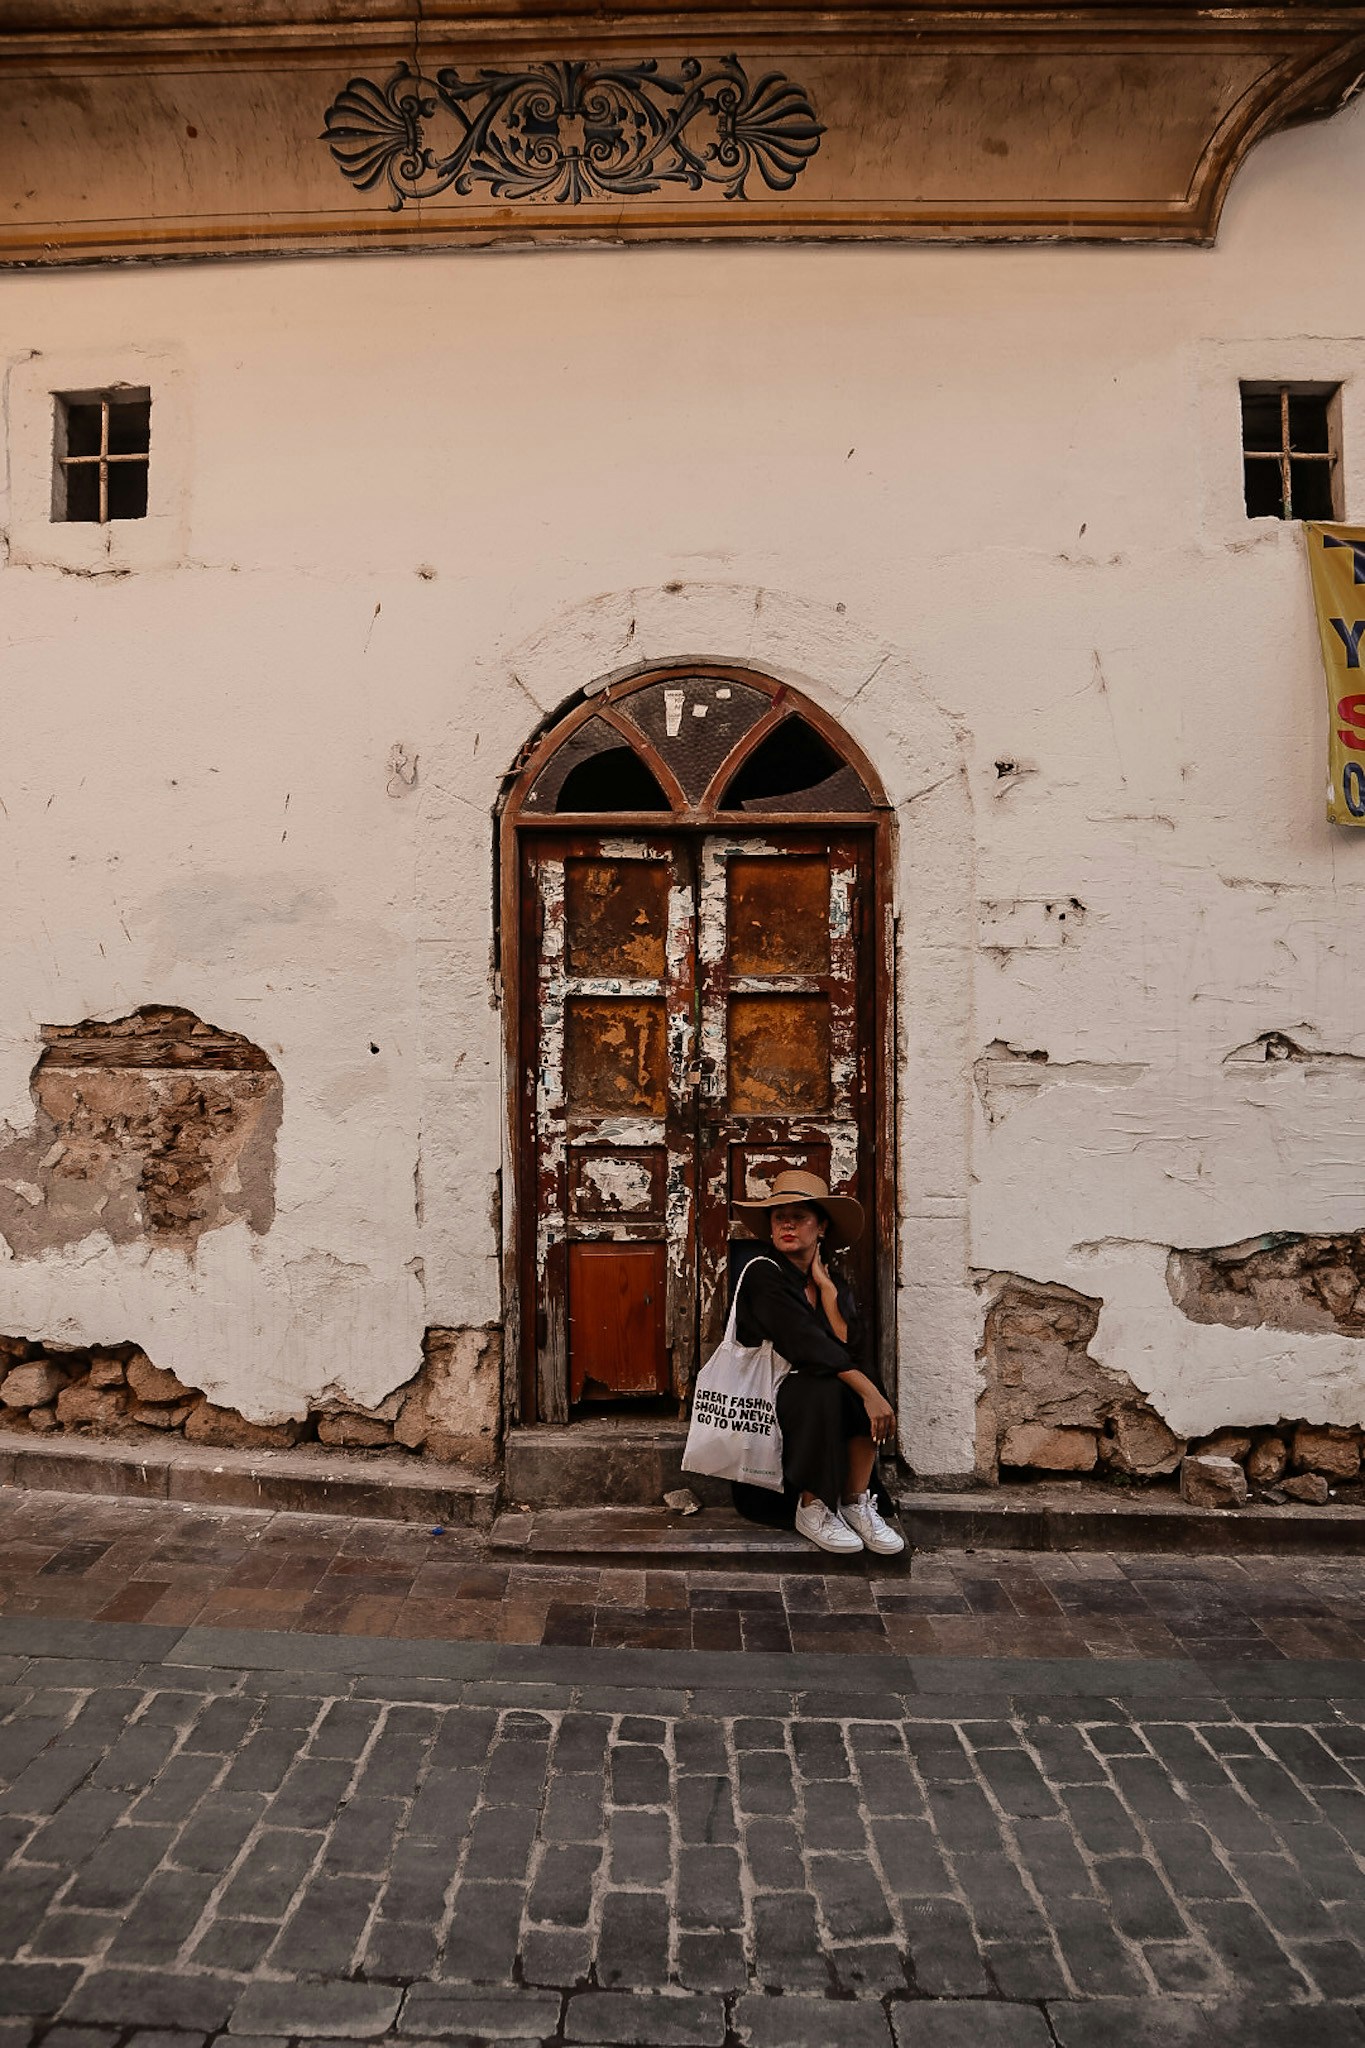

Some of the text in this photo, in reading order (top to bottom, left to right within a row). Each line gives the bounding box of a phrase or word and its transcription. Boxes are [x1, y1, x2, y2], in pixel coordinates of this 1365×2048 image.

[697, 1389, 728, 1405] GREAT
[695, 1400, 776, 1425] SHOULD NEVER
[697, 1413, 772, 1436] GO TO WASTE
